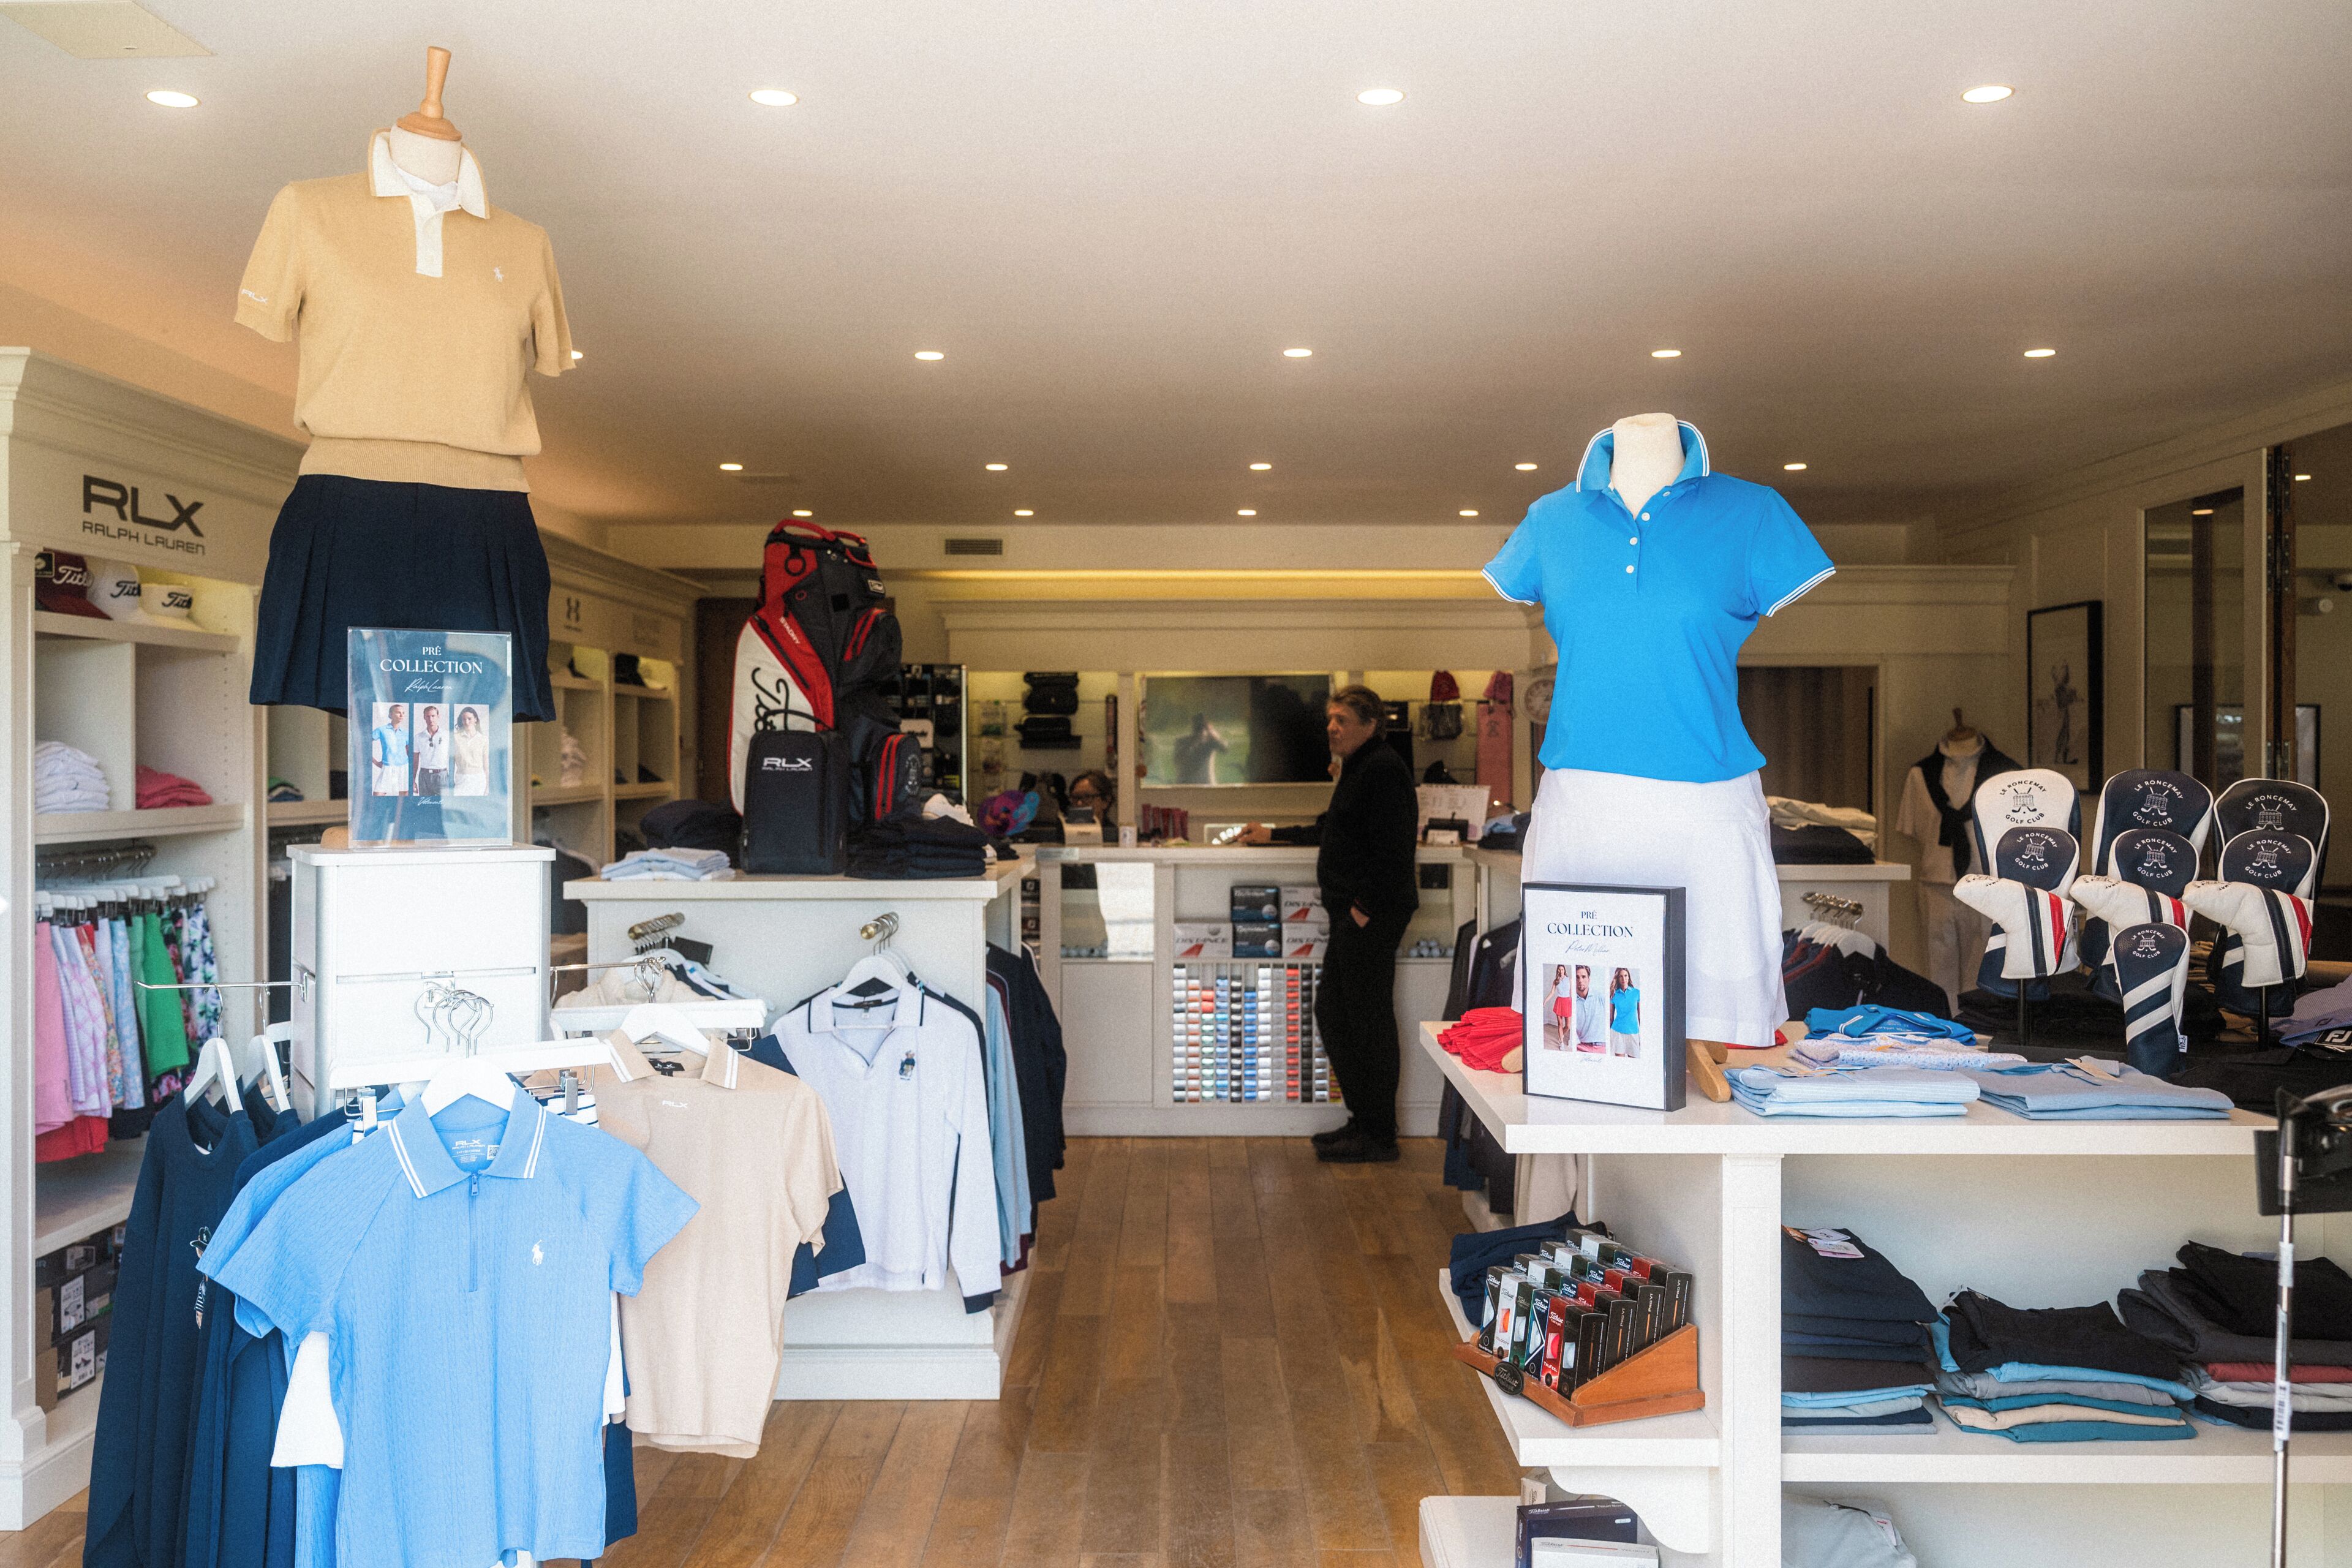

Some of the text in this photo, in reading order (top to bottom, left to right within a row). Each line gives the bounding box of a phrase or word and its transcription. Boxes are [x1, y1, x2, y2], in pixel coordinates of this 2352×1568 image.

[241, 288, 268, 304] RLX
[83, 474, 204, 538] RLX
[82, 521, 205, 556] RALPH LAUREN
[380, 658, 483, 674] COLLECTION
[763, 757, 812, 767] RLX
[2007, 780, 2047, 793] RONCEMAY
[2134, 780, 2184, 799] LE RONCEMAY
[2245, 794, 2297, 811] LE RONCEMAY
[2005, 812, 2045, 824] GOLF CLUB
[2133, 811, 2173, 826] GOLF CLUB
[2025, 833, 2057, 848] RONCEMAY
[2141, 838, 2177, 853] RONCEMAY
[2256, 839, 2291, 854] RONCEMAY
[2015, 858, 2030, 869] GOLF
[2137, 867, 2173, 878] GOLF CLUB
[2245, 866, 2282, 878] GOLF CLUB
[1547, 922, 1633, 938] COLLECTION
[2137, 929, 2165, 939] RONCEMAY
[2324, 1030, 2352, 1043] FJ
[662, 1100, 688, 1109] RLX
[1540, 1250, 1553, 1261] Titleist
[1513, 1261, 1528, 1272] Titleist
[1615, 1257, 1630, 1269] Titleist
[1487, 1274, 1501, 1286] Titleist
[1589, 1270, 1604, 1282] Titleist
[1501, 1288, 1514, 1299] Titleist
[1561, 1283, 1577, 1295] Titleist
[1534, 1298, 1548, 1310] Titleist
[1549, 1311, 1564, 1324] Titleist
[1495, 1367, 1519, 1387] Titleist
